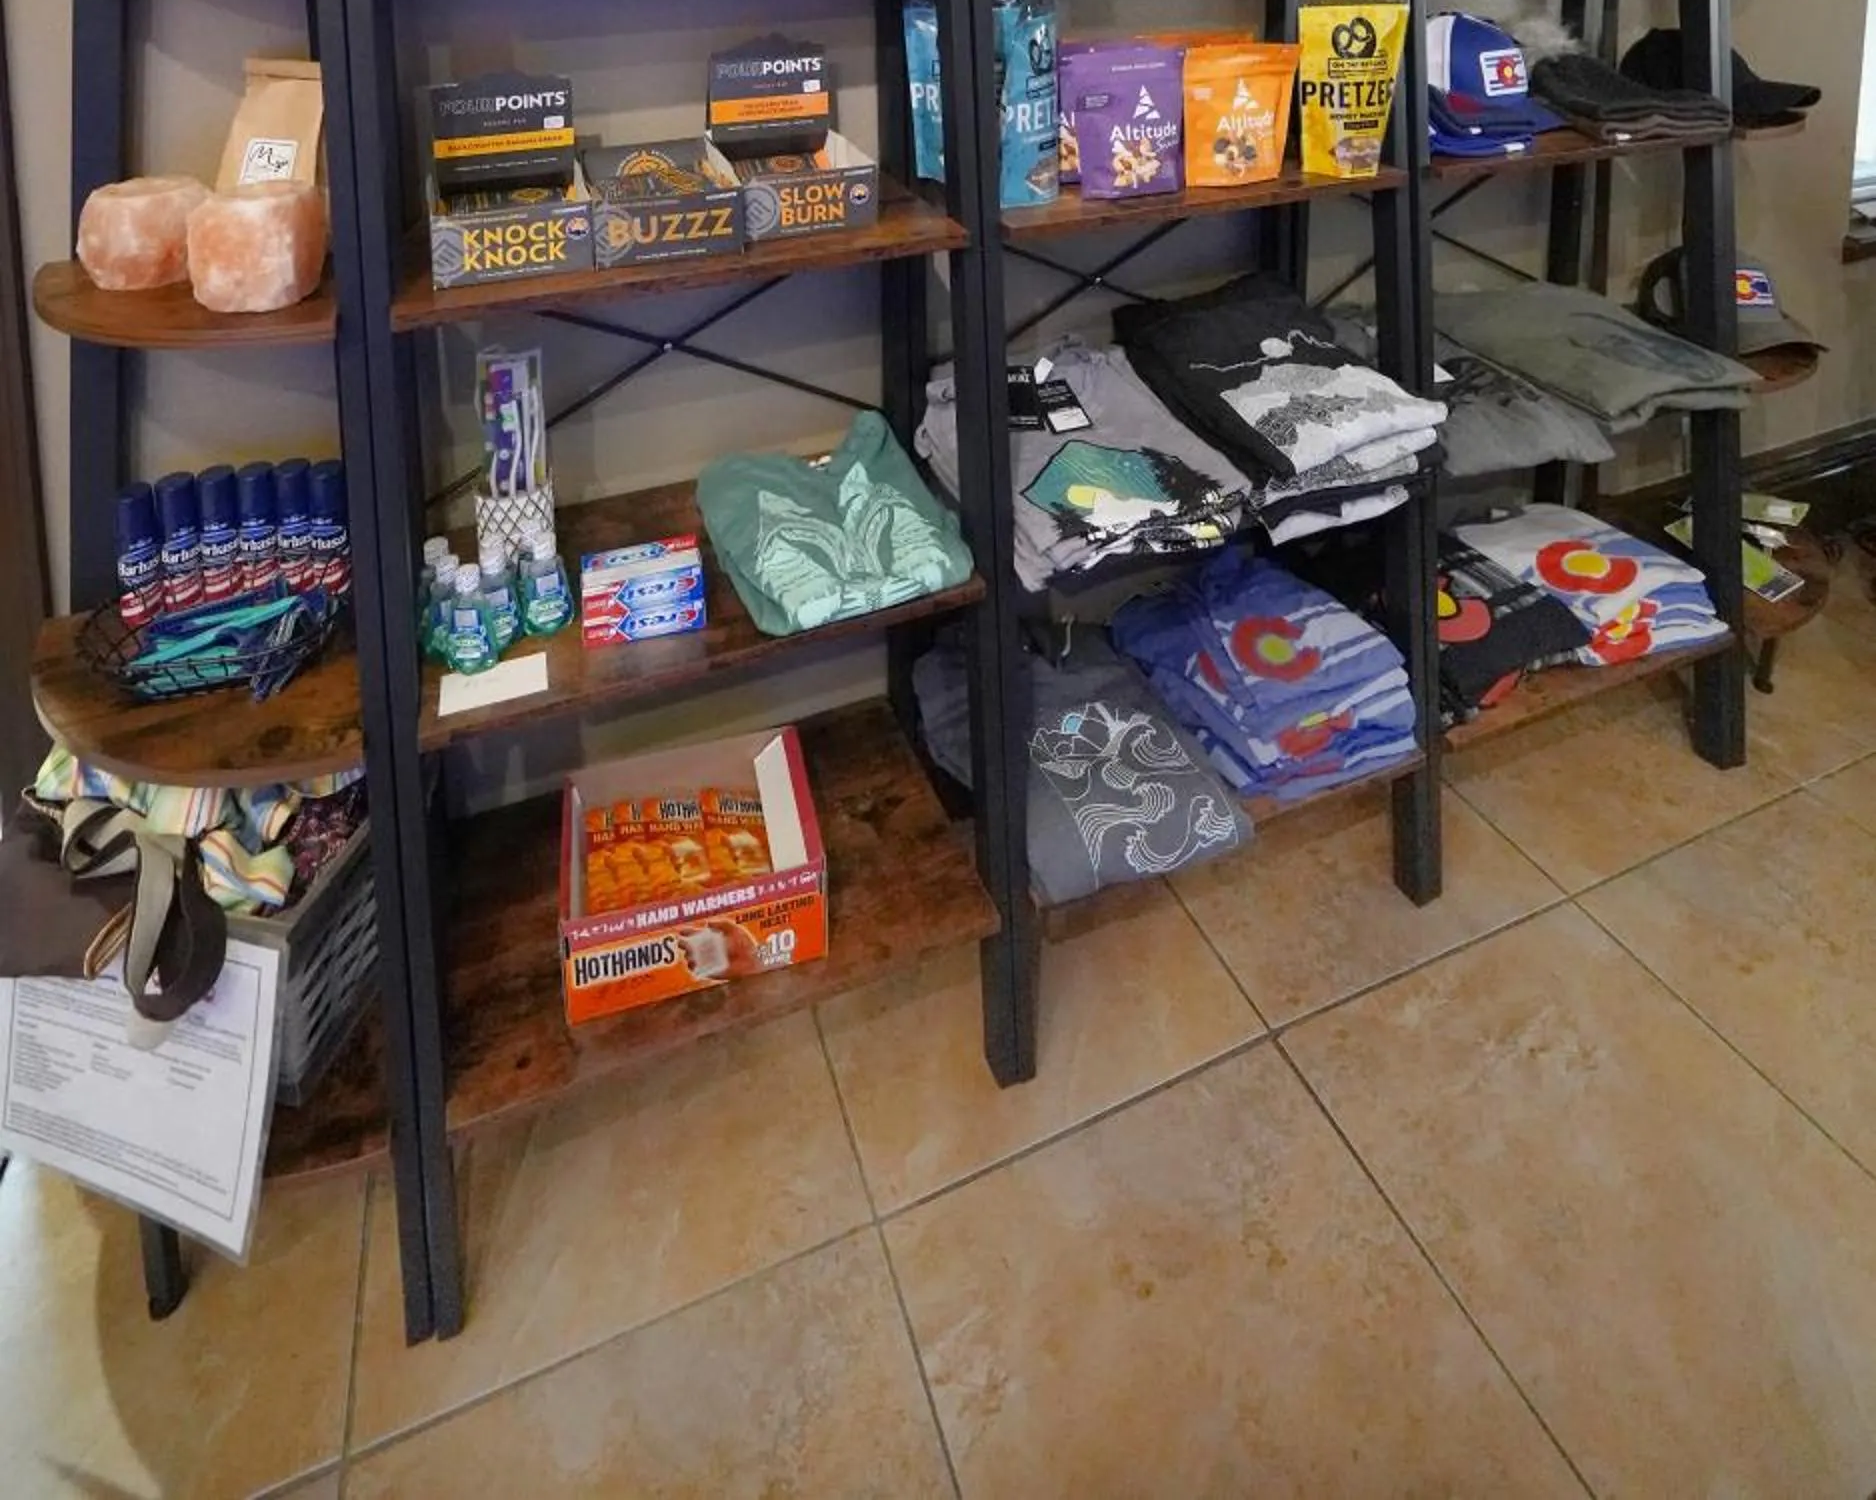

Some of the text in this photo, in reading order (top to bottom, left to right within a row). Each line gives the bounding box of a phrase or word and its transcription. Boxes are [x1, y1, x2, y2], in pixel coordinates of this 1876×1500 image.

[1109, 122, 1178, 142] Altitude
[779, 181, 846, 206] SLOW
[606, 206, 734, 252] BUZZZ
[780, 202, 846, 228] BURN
[462, 217, 567, 251] KNOCK
[462, 240, 568, 273] KNOCK
[635, 908, 679, 930] HAND
[681, 885, 757, 918] WARMERS
[736, 906, 766, 925] LONG
[766, 929, 796, 957] 10
[574, 935, 676, 986] HOTHANDS
